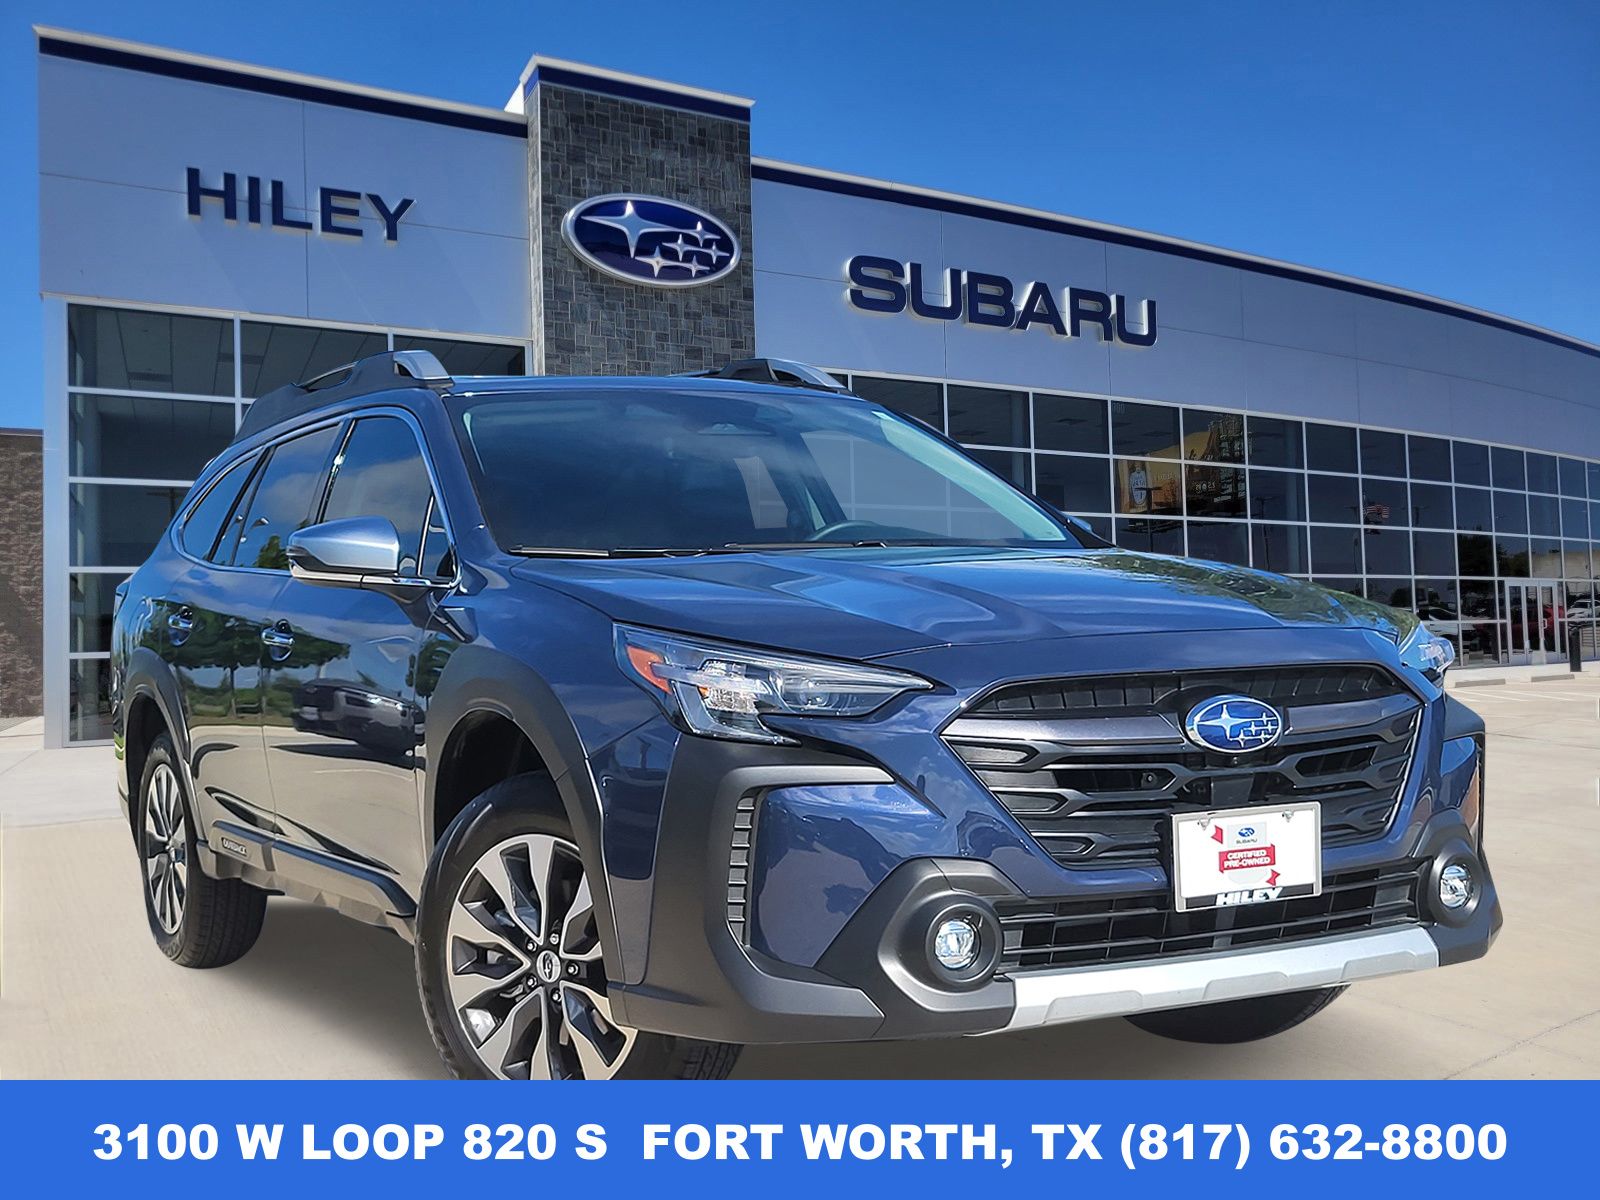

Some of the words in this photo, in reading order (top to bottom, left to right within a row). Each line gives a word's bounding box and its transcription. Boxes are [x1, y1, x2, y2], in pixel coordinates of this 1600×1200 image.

[186, 167, 416, 242] HILEY
[847, 254, 1159, 347] SUBARU
[1223, 857, 1271, 869] PRE-OWNED
[1227, 850, 1267, 860] CERTIFIED
[1215, 886, 1284, 906] HILEY
